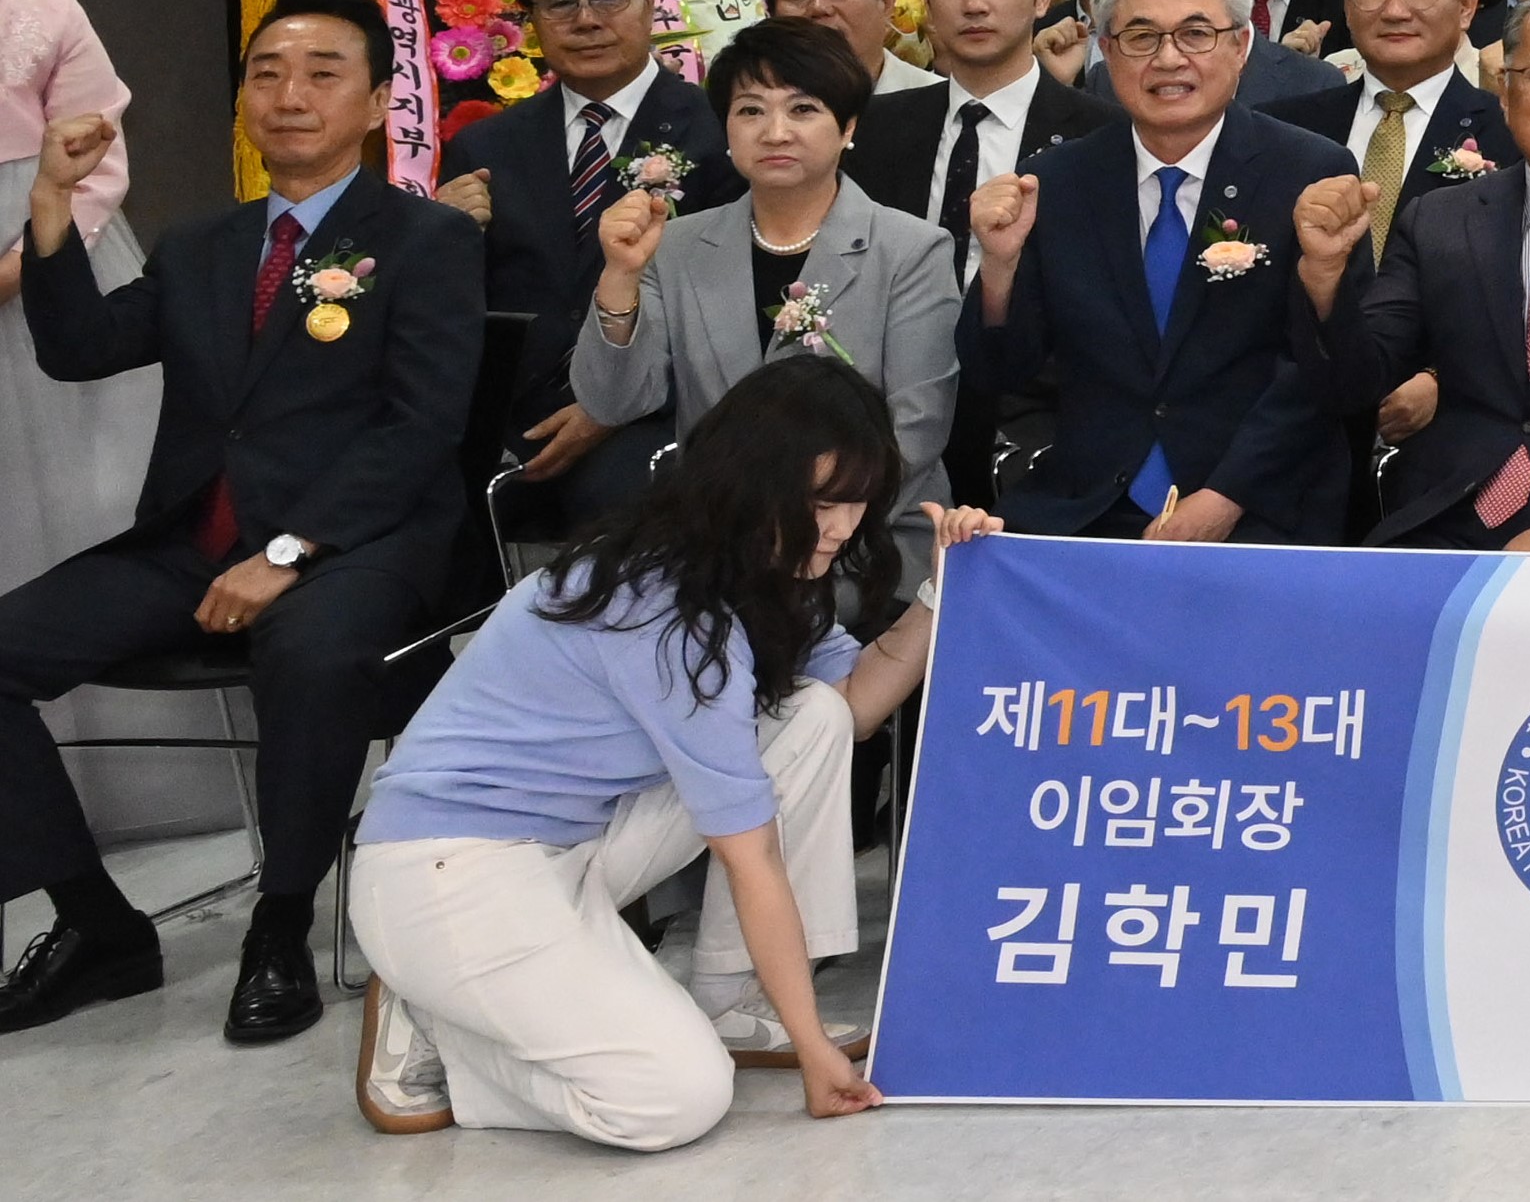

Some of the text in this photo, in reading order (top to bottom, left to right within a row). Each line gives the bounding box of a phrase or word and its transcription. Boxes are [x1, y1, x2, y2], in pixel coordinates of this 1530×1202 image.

[976, 681, 1366, 759] 제11대~13대
[1030, 776, 1304, 851] 이임회장
[987, 883, 1307, 988] 김학민
